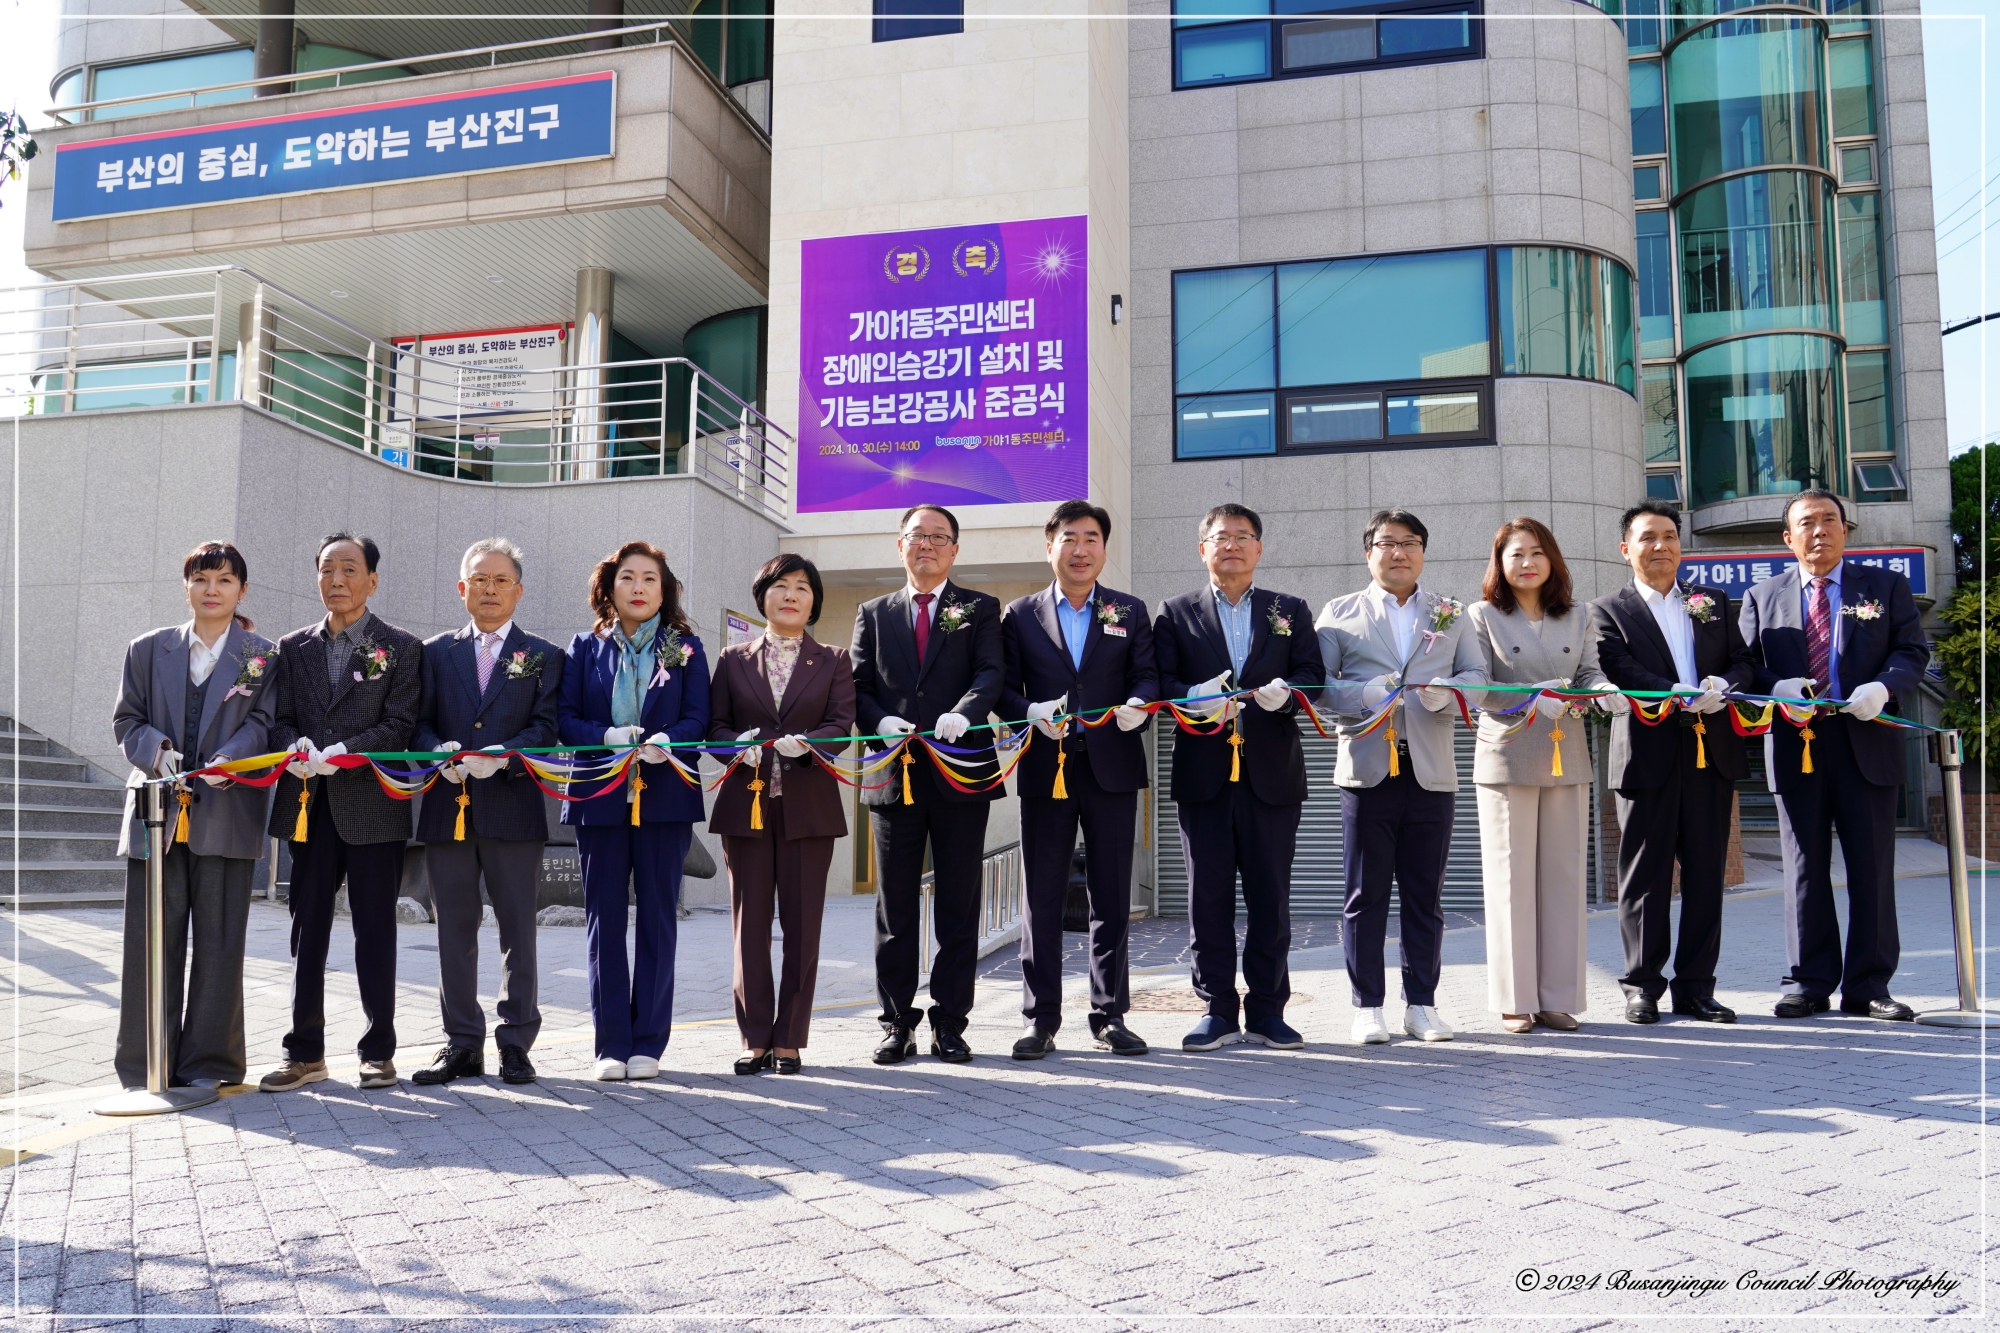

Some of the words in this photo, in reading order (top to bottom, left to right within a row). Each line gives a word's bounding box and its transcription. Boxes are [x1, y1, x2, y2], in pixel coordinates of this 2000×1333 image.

[97, 152, 184, 193] 부산의
[198, 143, 268, 182] 중심,
[283, 126, 410, 170] 도약하는
[426, 104, 559, 153] 부산진구
[896, 252, 918, 276] 경
[965, 245, 987, 269] 축
[849, 298, 1035, 342] 가야1동주민센터
[429, 344, 454, 356] 부산의
[458, 343, 478, 355] 중심,
[481, 340, 516, 352] 도약하는
[520, 336, 555, 349] 부산진구
[823, 346, 971, 386] 장애인승강기
[979, 342, 1030, 376] 설치
[1038, 340, 1064, 372] 및
[820, 388, 977, 428] 기능보강공사
[985, 382, 1065, 418] 준공식
[819, 443, 844, 456] 2024.
[847, 443, 860, 454] 10.
[862, 441, 892, 454] 30.(수)
[895, 440, 920, 452] 14:00
[935, 435, 982, 449] busanjin
[983, 431, 1065, 447] 가야1동주민센터
[1685, 562, 1772, 585] 가야1동
